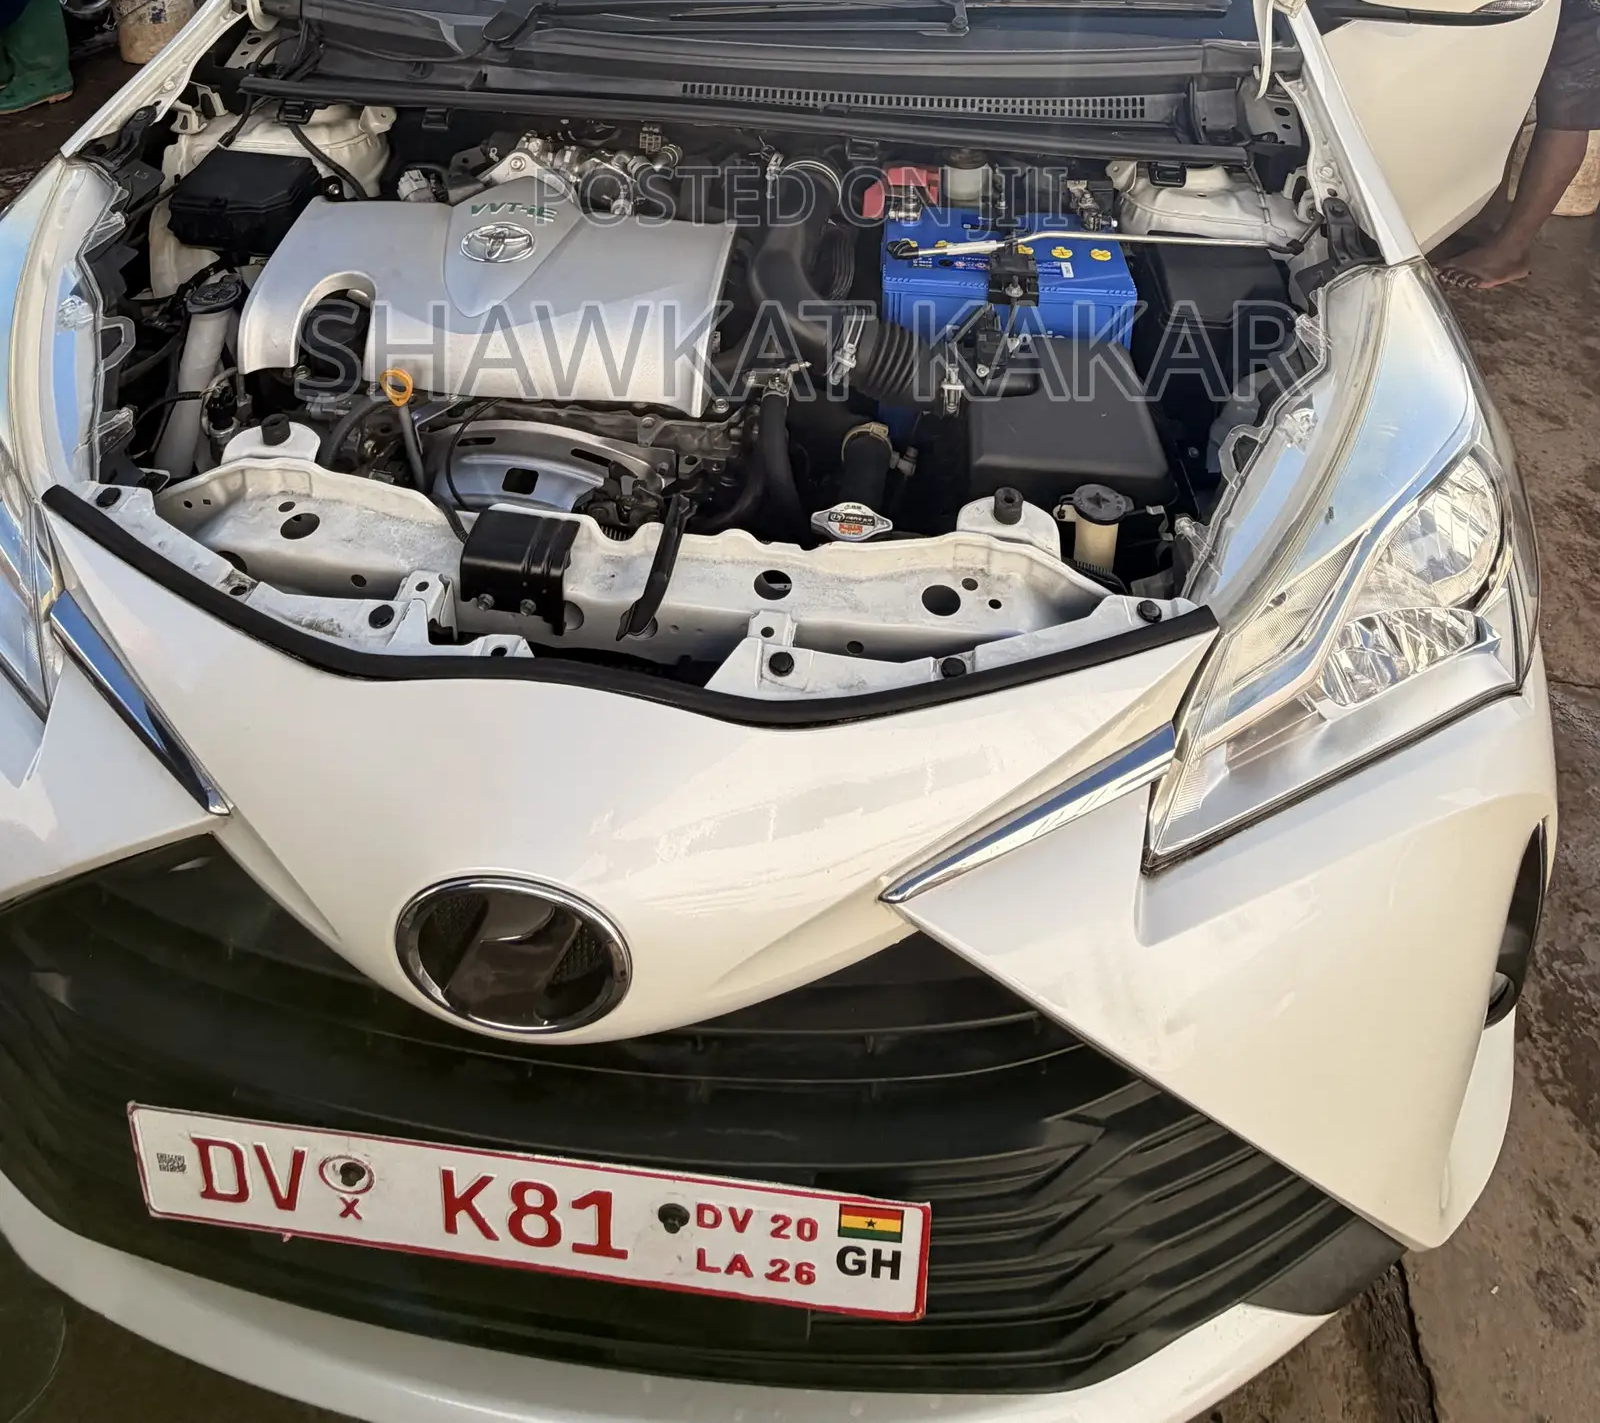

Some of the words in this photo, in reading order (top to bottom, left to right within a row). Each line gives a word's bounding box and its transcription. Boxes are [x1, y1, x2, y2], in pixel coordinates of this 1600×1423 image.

[191, 1135, 307, 1211] DV
[440, 1168, 629, 1260] K81
[696, 1202, 754, 1234] DV
[770, 1213, 819, 1242] 20
[696, 1247, 754, 1278] LA
[764, 1258, 816, 1286] 26
[836, 1245, 902, 1281] GH
